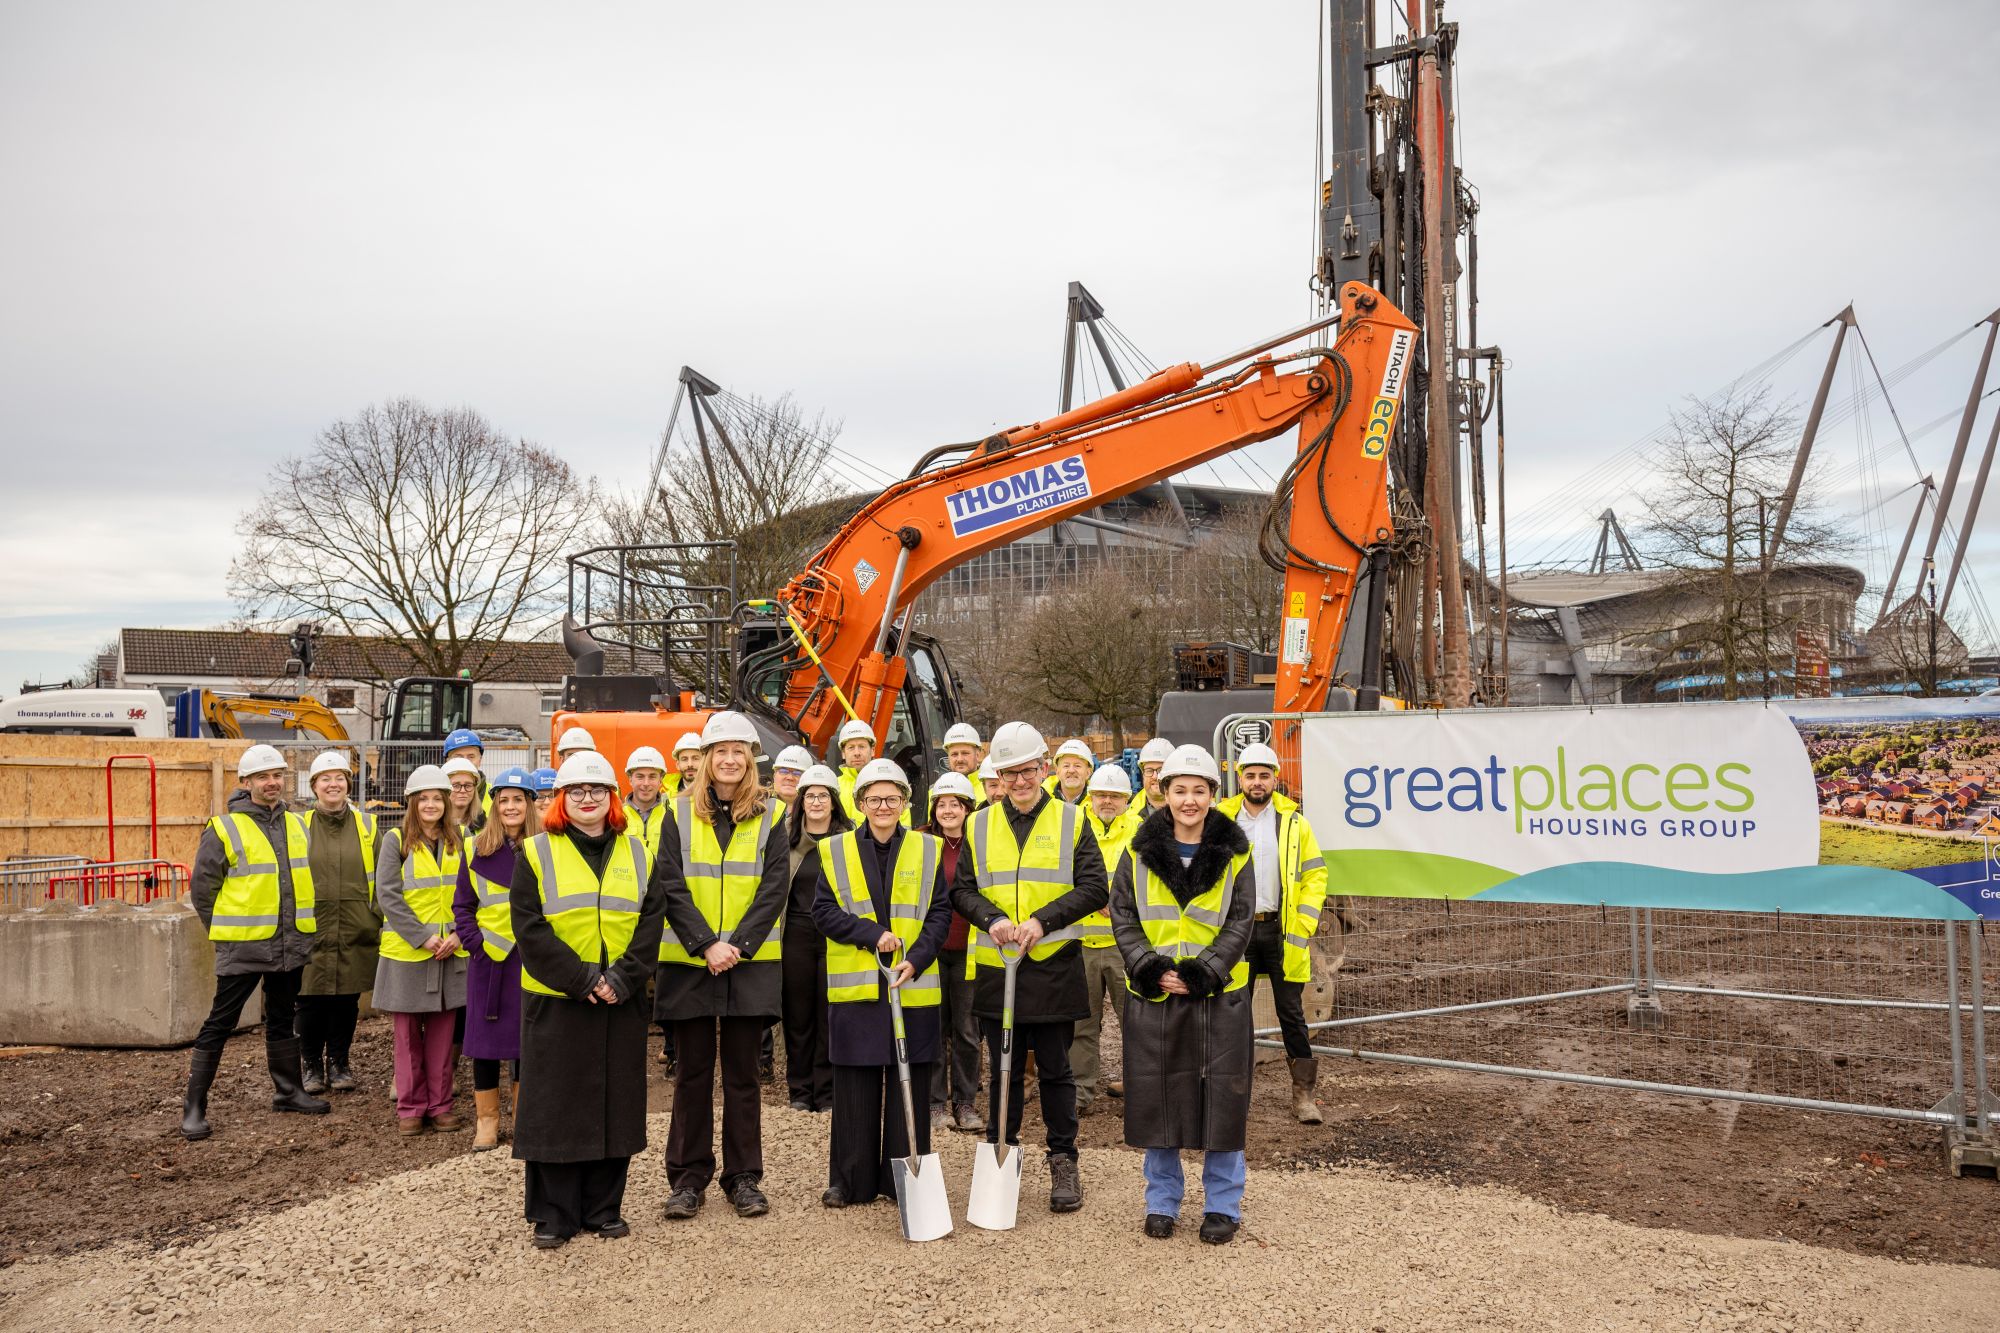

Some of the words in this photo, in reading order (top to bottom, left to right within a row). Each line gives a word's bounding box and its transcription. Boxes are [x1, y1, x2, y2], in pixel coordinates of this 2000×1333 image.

[1384, 334, 1408, 394] HITACHI
[946, 456, 1085, 518] THOMAS
[1016, 494, 1055, 514] PLANT
[1057, 484, 1087, 502] HIRE
[914, 611, 971, 626] STADIUM
[17, 709, 115, 719] thomasplanthire.co.uk
[1529, 818, 1648, 836] HOUSING
[1660, 819, 1757, 838] GROUP
